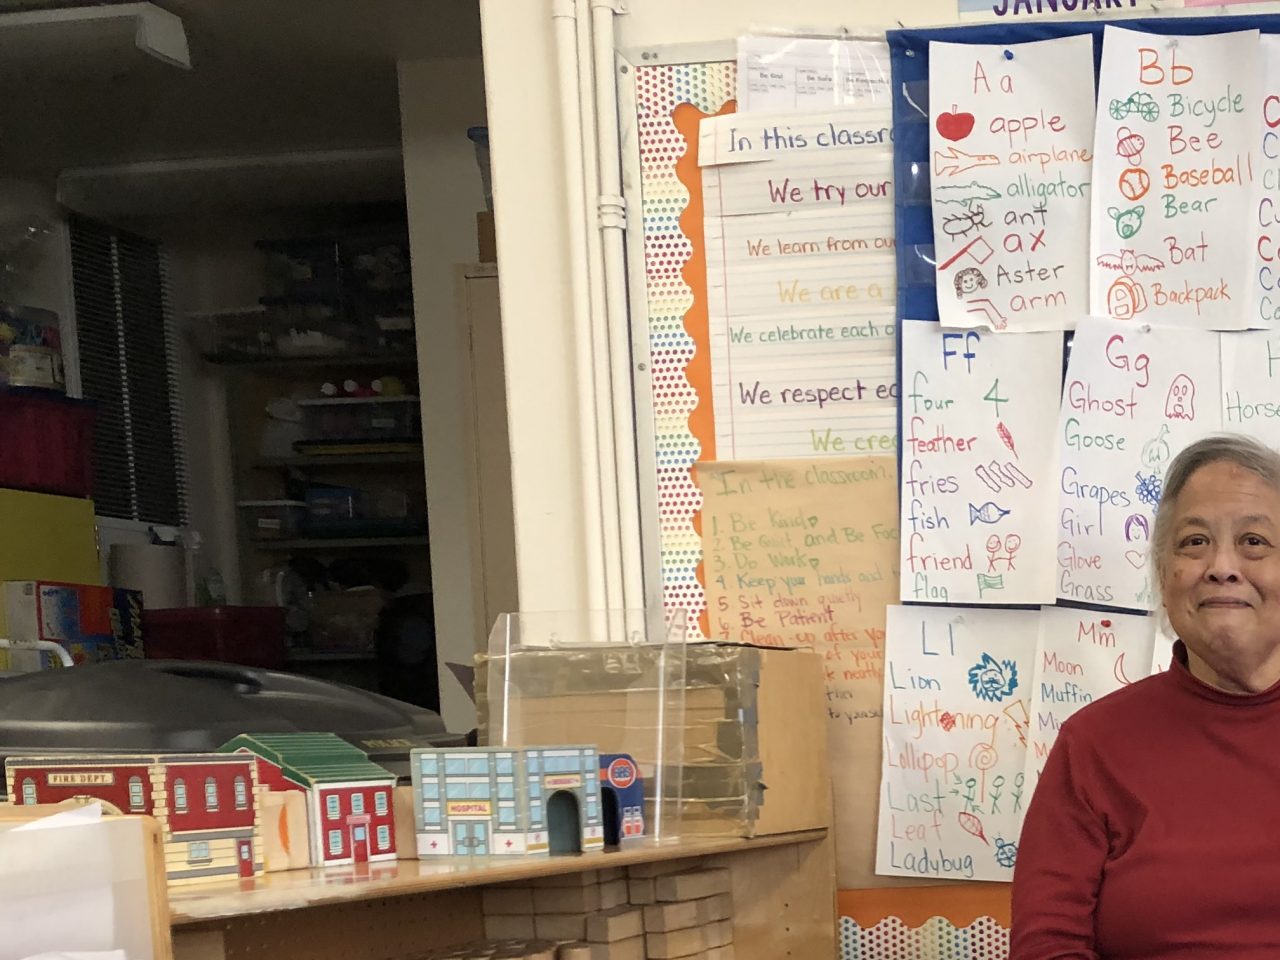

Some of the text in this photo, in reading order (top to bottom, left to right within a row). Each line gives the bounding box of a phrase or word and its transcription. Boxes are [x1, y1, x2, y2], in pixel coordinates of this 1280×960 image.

[1168, 85, 1245, 127] Bicycle
[728, 127, 808, 152] In this
[990, 109, 1066, 148] apple
[1167, 126, 1222, 154] Bee
[1009, 148, 1092, 173] airplane
[1161, 155, 1253, 189] Baseball
[768, 178, 892, 205] We try our
[1006, 172, 1091, 206] alligator
[1004, 202, 1047, 226] ant
[1162, 194, 1217, 218] Bear
[747, 237, 868, 256] We learn from
[1003, 229, 1045, 252] ax
[1164, 231, 1208, 265] Bat
[996, 262, 1065, 287] Aster
[1010, 290, 1067, 311] arm
[1154, 278, 1231, 315] Backpack
[729, 321, 878, 343] We celebrate each
[739, 380, 866, 408] We respect
[908, 371, 1009, 417] four 4
[1069, 381, 1137, 419] Ghost
[810, 428, 845, 451] We
[907, 417, 977, 452] feather
[1065, 418, 1126, 450] Goose
[906, 460, 959, 495] fries
[1061, 467, 1130, 513] Grapes
[908, 499, 950, 529] fish
[1061, 508, 1103, 536] Girl
[907, 533, 973, 572] friend
[1057, 541, 1102, 570] Glove
[1061, 570, 1114, 601] Grass
[890, 661, 941, 691] Lion
[1043, 651, 1084, 676] Moon
[1041, 682, 1092, 703] Muffin
[52, 773, 108, 782] FIRE DEPT.
[450, 804, 487, 813] HOSPITAL
[887, 778, 946, 813] Last
[892, 810, 944, 840] Leaf
[891, 841, 974, 877] Ladybug
